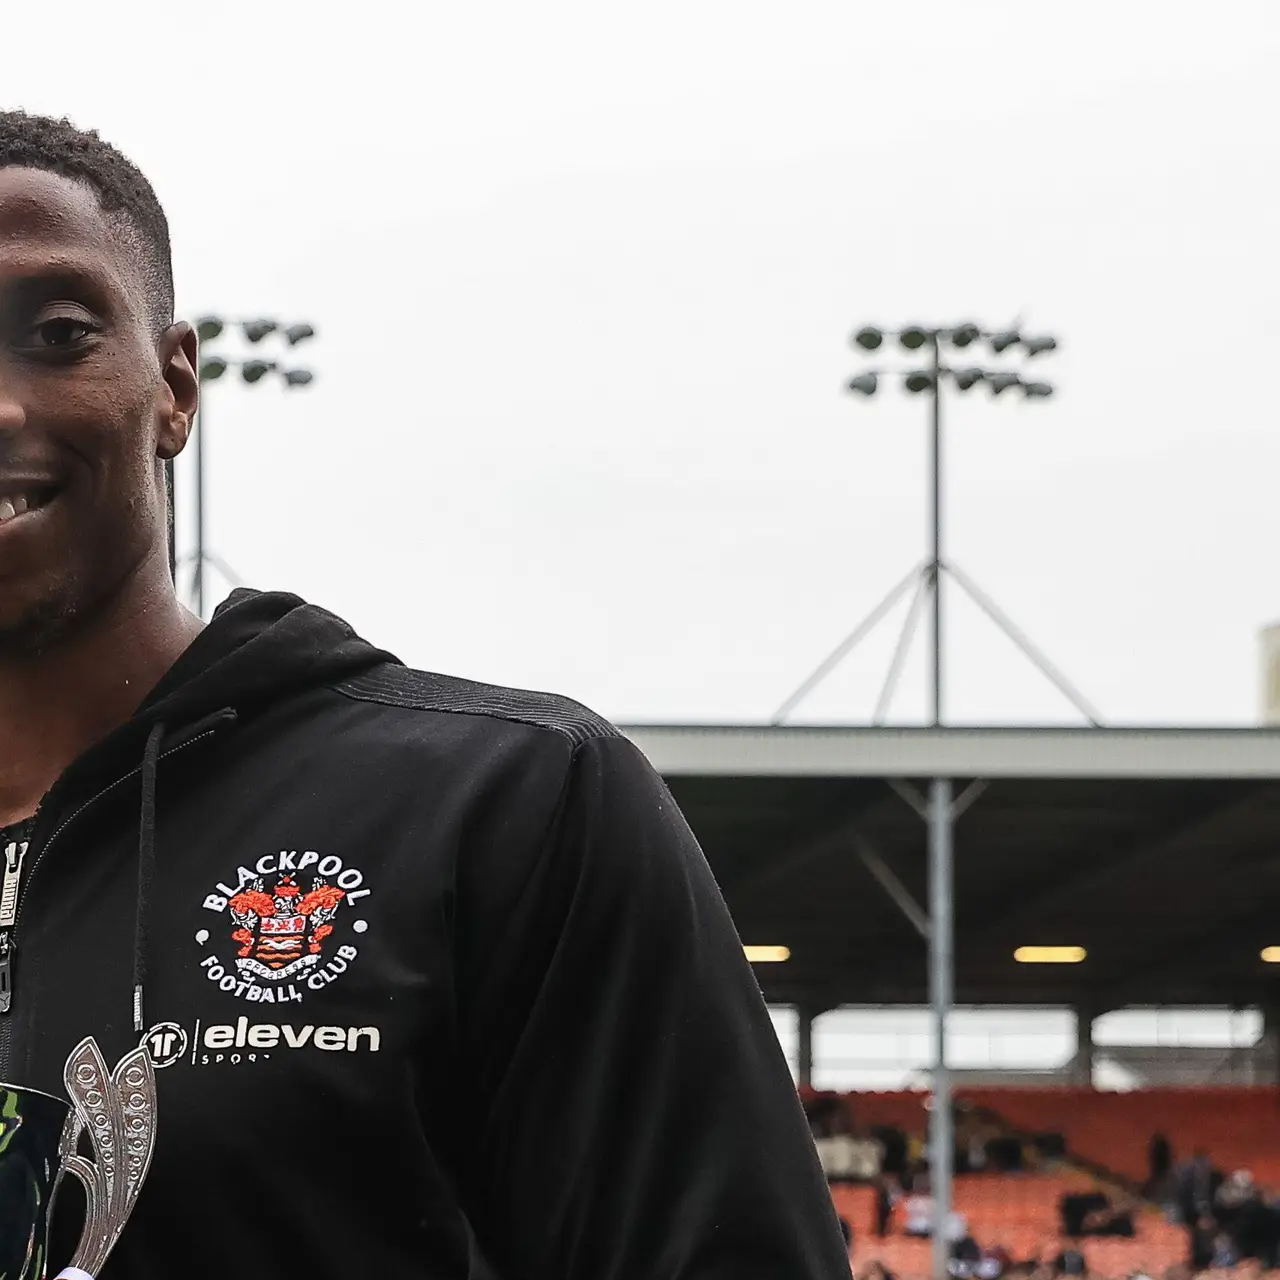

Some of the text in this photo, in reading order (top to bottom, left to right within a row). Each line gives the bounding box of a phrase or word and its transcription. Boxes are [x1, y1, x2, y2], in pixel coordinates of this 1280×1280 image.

[202, 850, 371, 912] BLACKPOOL
[200, 945, 358, 1003] FOOTBALL CLUB
[203, 1016, 381, 1052] eleven
